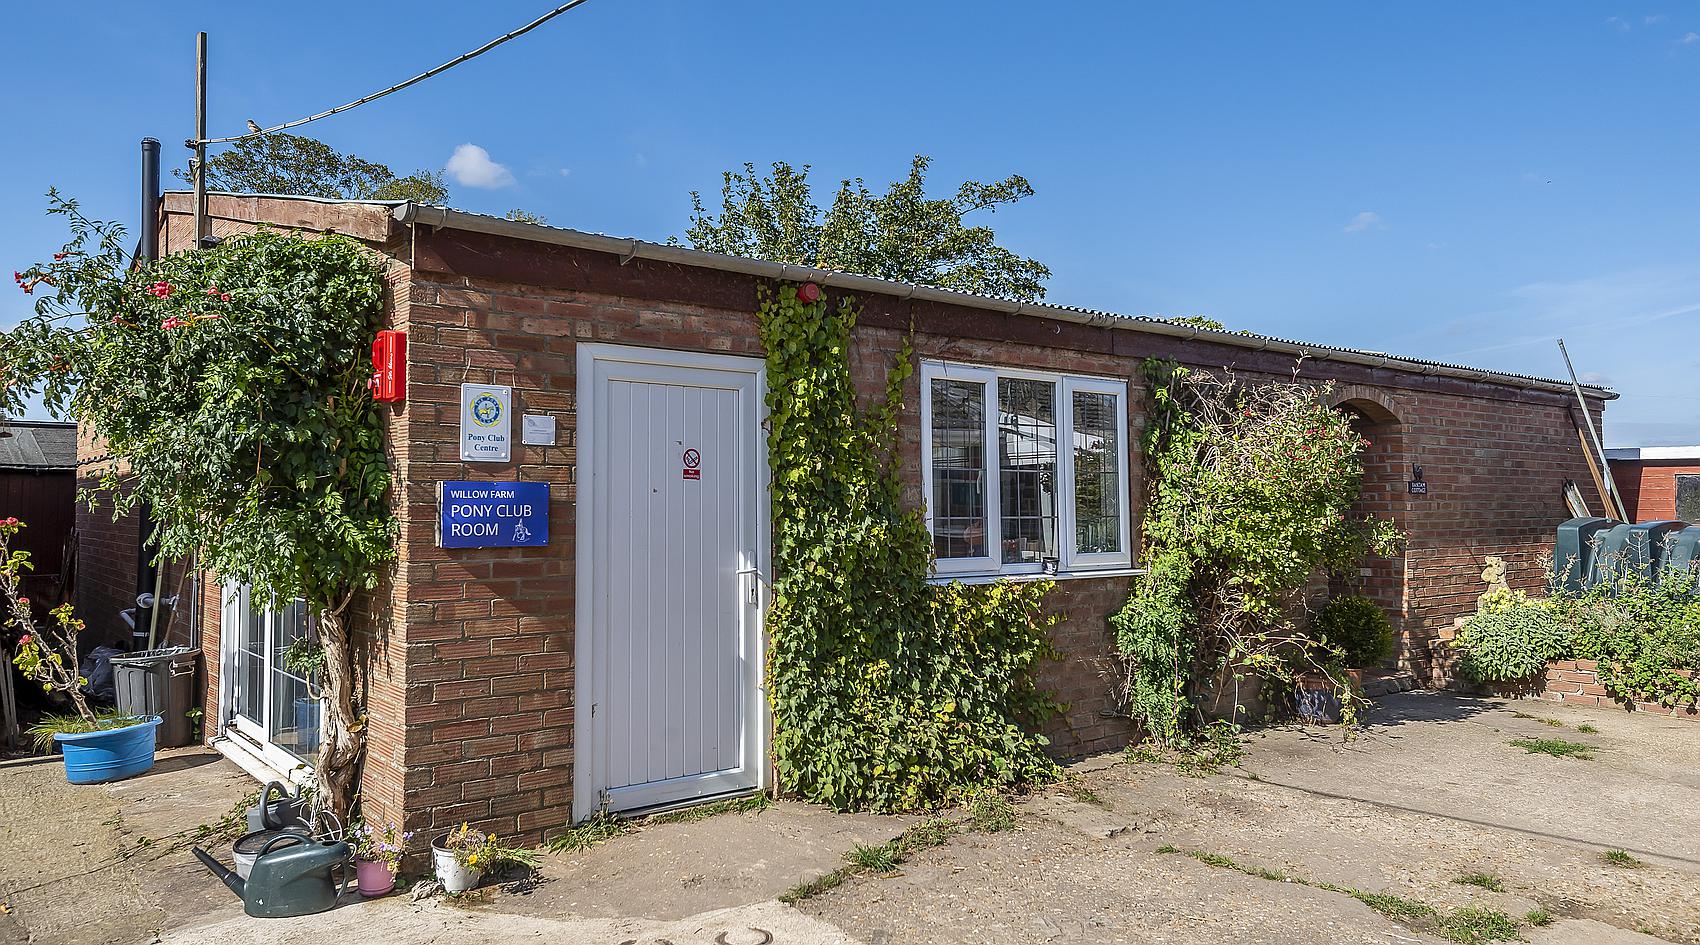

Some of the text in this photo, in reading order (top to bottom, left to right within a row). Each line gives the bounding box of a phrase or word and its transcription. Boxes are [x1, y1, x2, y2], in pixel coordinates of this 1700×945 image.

[468, 433, 505, 443] Pony Club
[474, 443, 499, 452] Centre
[450, 490, 515, 499] WILLOW FARM
[451, 504, 532, 518] PONY CLUB
[451, 523, 499, 537] ROOM
